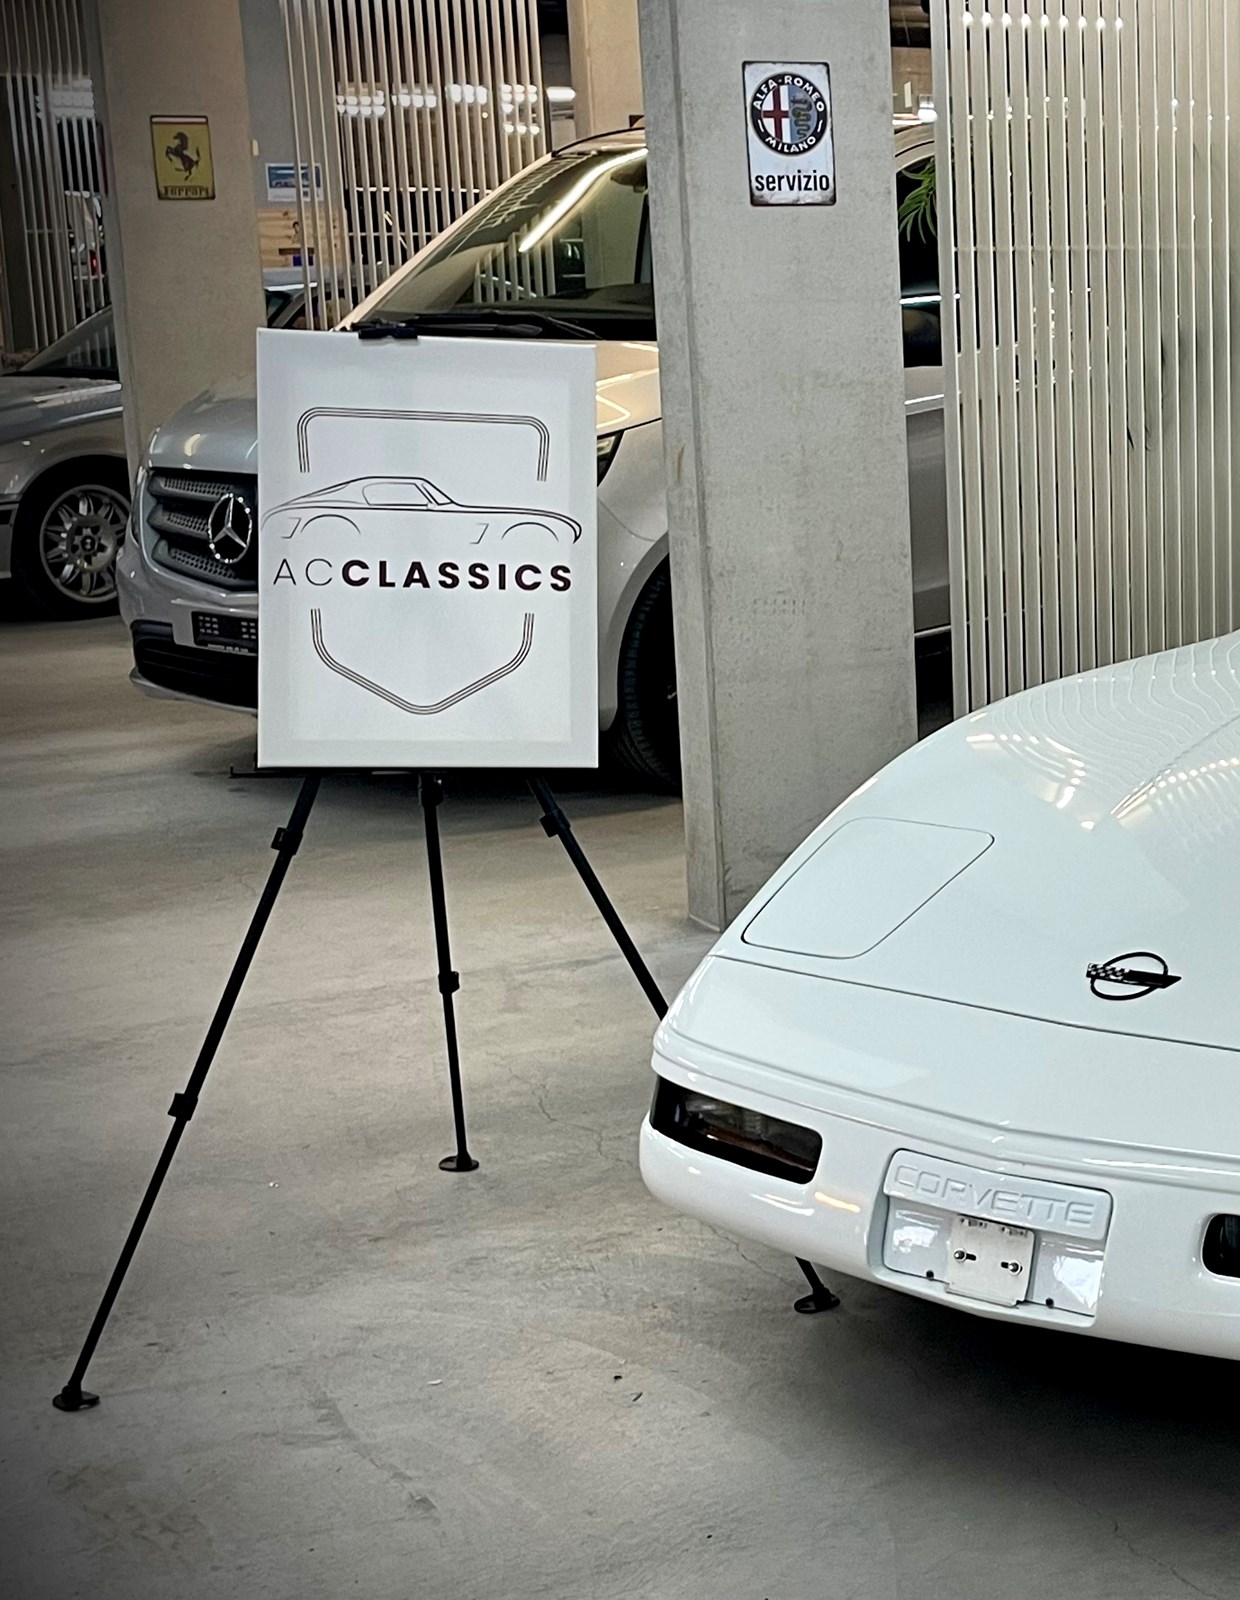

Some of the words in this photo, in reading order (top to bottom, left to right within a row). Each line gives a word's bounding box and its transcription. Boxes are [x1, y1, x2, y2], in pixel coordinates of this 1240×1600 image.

[765, 136, 816, 153] MILANO
[164, 185, 209, 196] Ferrari
[754, 169, 830, 192] servizio
[895, 1164, 1095, 1229] CORVETTE
